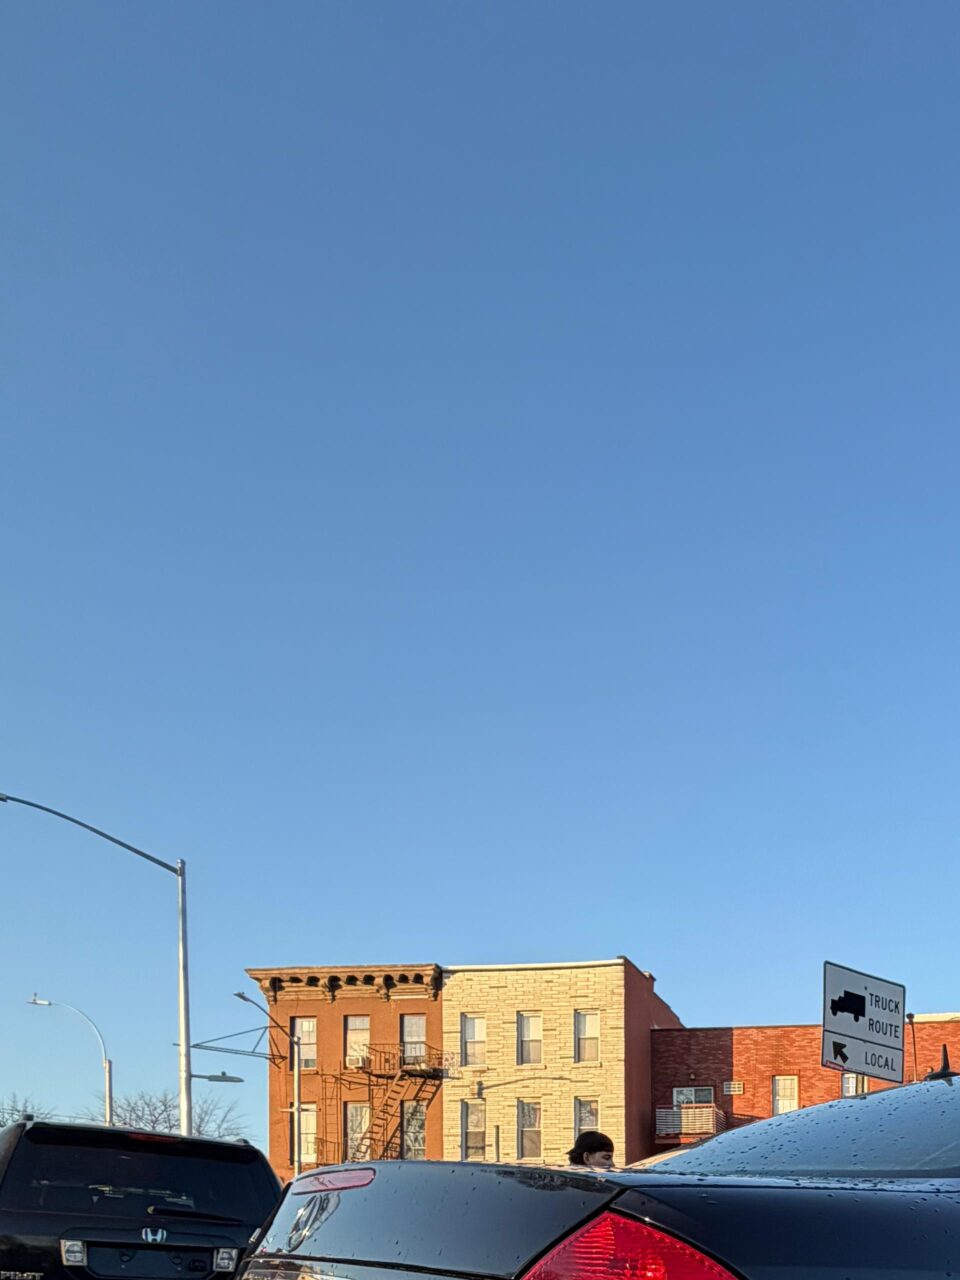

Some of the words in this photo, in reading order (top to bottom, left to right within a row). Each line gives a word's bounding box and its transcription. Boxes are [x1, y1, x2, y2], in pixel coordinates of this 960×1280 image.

[869, 993, 900, 1014] TRUCK
[869, 1018, 900, 1039] ROUTE
[865, 1051, 896, 1071] LOCAL
